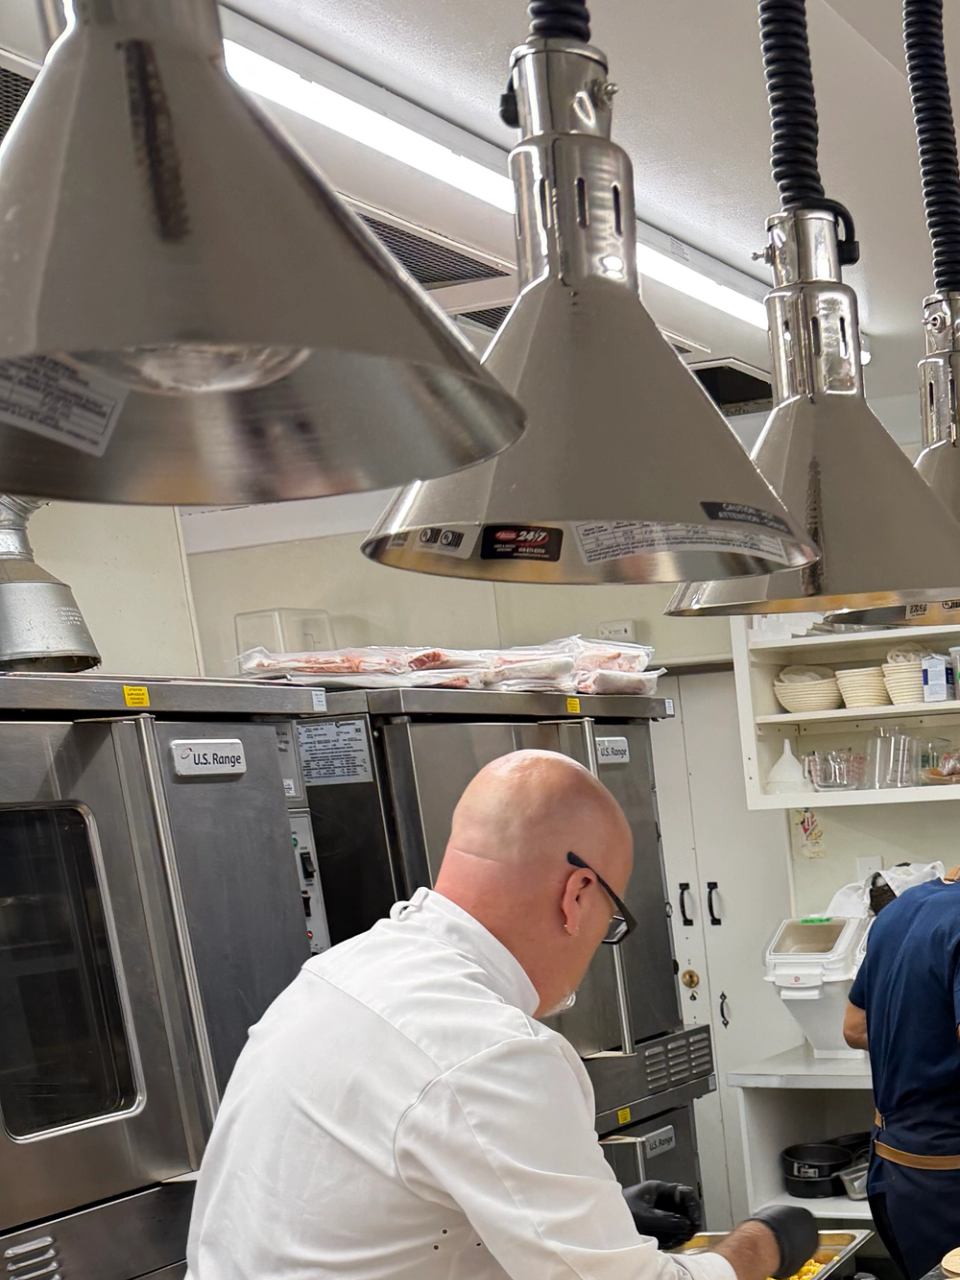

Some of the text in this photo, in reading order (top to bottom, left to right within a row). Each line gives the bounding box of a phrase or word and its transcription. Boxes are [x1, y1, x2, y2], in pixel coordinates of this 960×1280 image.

[601, 747, 628, 759] U.S. Range
[193, 753, 242, 768] U.S. Range
